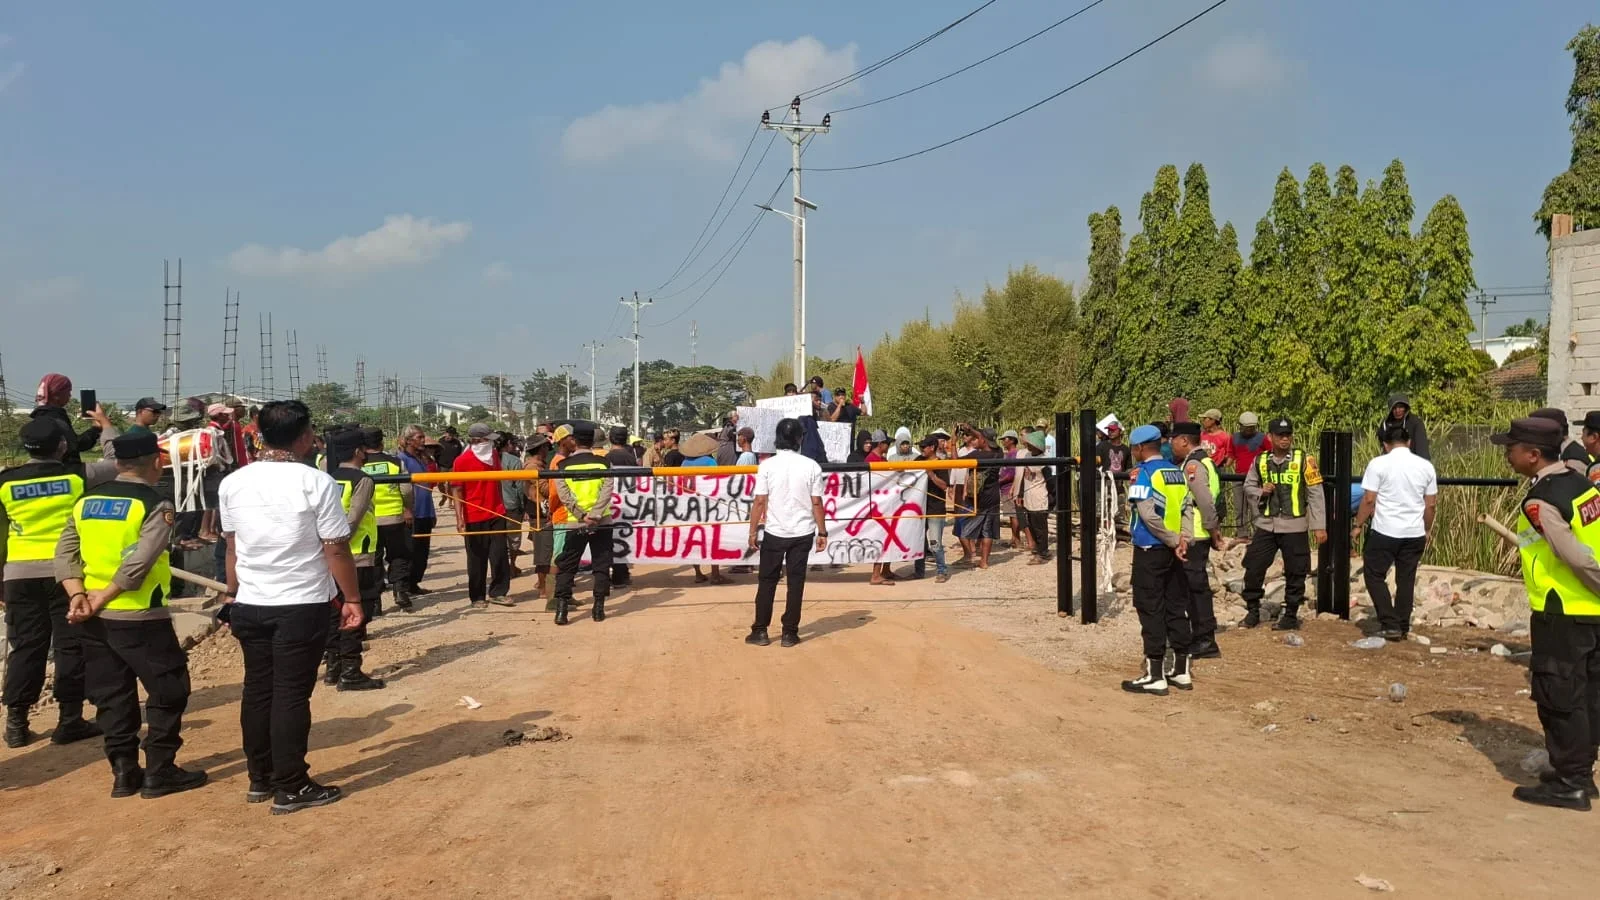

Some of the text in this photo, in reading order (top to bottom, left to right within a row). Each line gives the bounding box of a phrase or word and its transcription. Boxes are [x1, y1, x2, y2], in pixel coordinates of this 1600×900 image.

[12, 480, 69, 499] POLISI
[83, 500, 130, 517] POLSI
[610, 492, 757, 524] SYARAKAT
